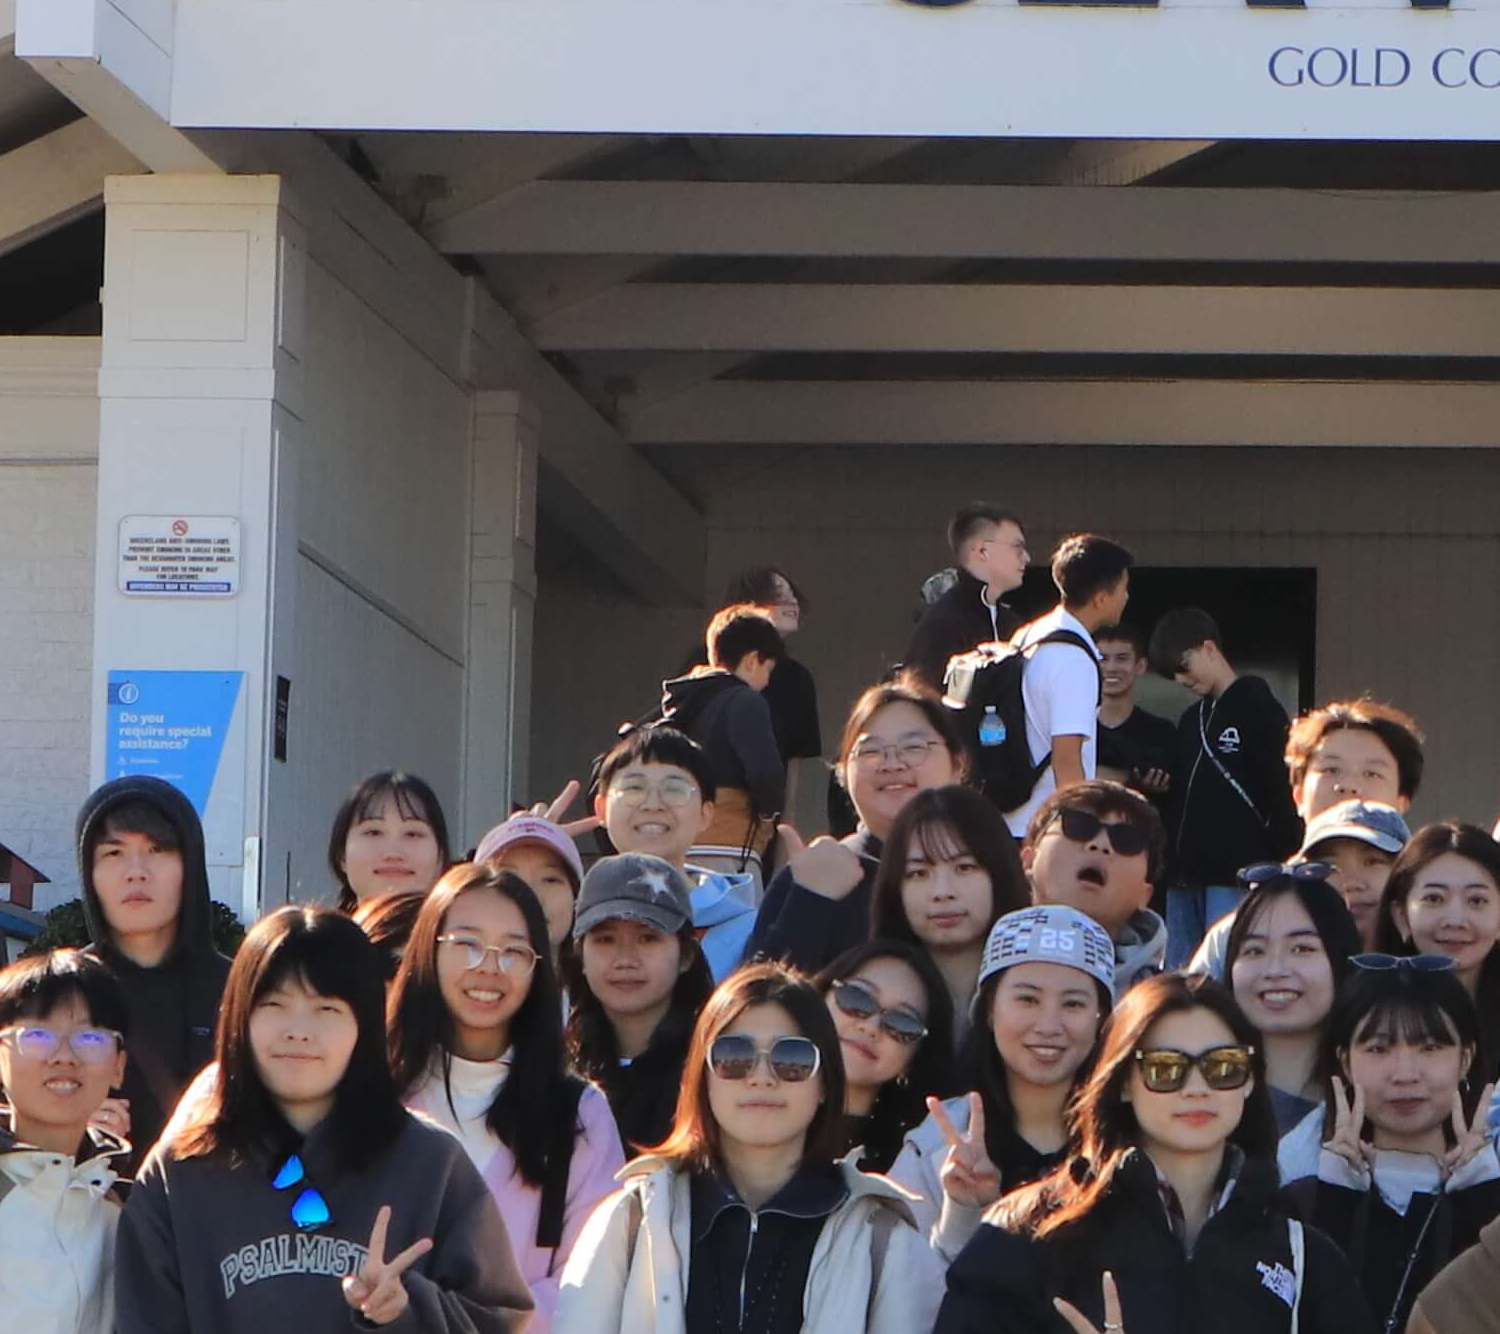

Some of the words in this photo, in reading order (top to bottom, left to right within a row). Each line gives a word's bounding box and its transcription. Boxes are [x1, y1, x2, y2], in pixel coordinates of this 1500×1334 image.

[1269, 46, 1411, 89] GOLD
[119, 712, 137, 723] Do
[140, 714, 164, 726] you
[119, 726, 166, 739] require
[167, 726, 212, 739] special
[118, 738, 189, 749] assistance?
[1040, 928, 1076, 952] 25
[220, 1234, 371, 1299] PSALMIST
